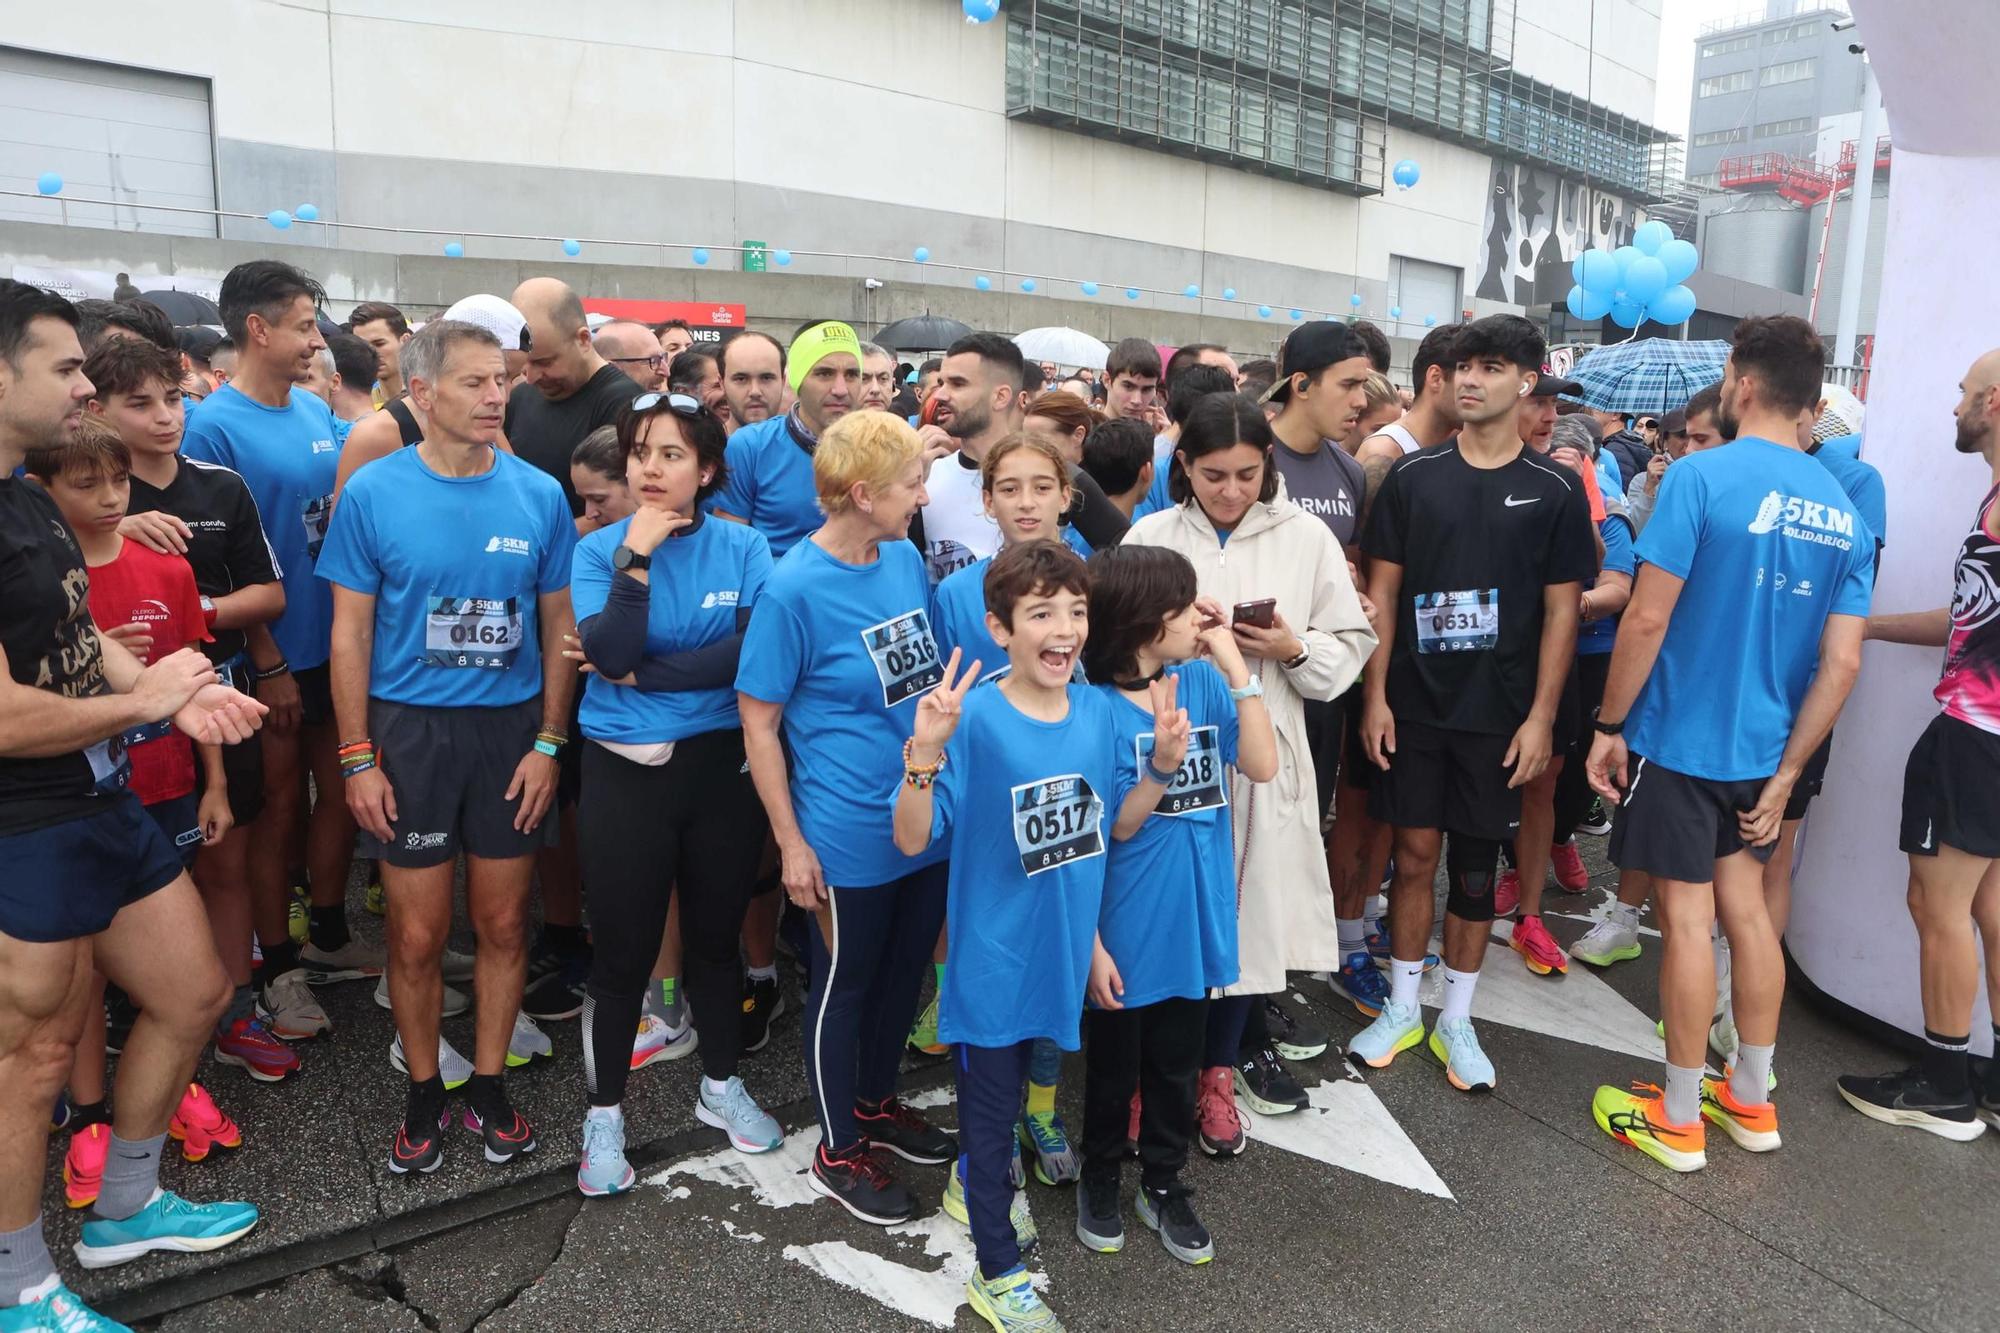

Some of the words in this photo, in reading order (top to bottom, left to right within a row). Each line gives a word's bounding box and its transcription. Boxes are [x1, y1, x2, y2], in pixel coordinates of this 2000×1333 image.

[1291, 496, 1353, 517] ARMIN
[1784, 496, 1854, 538] 5KM
[502, 537, 529, 551] 5KM
[1782, 525, 1853, 551] SOLIDARIOS
[475, 599, 505, 611] 5KM
[1448, 591, 1473, 601] 5KM
[131, 614, 169, 622] DEPORTE
[1432, 612, 1480, 632] 0631
[449, 624, 509, 645] 0162
[886, 636, 936, 677] 0516
[1168, 755, 1212, 788] 518
[1050, 779, 1075, 795] 5KM
[1025, 800, 1090, 845] 0517
